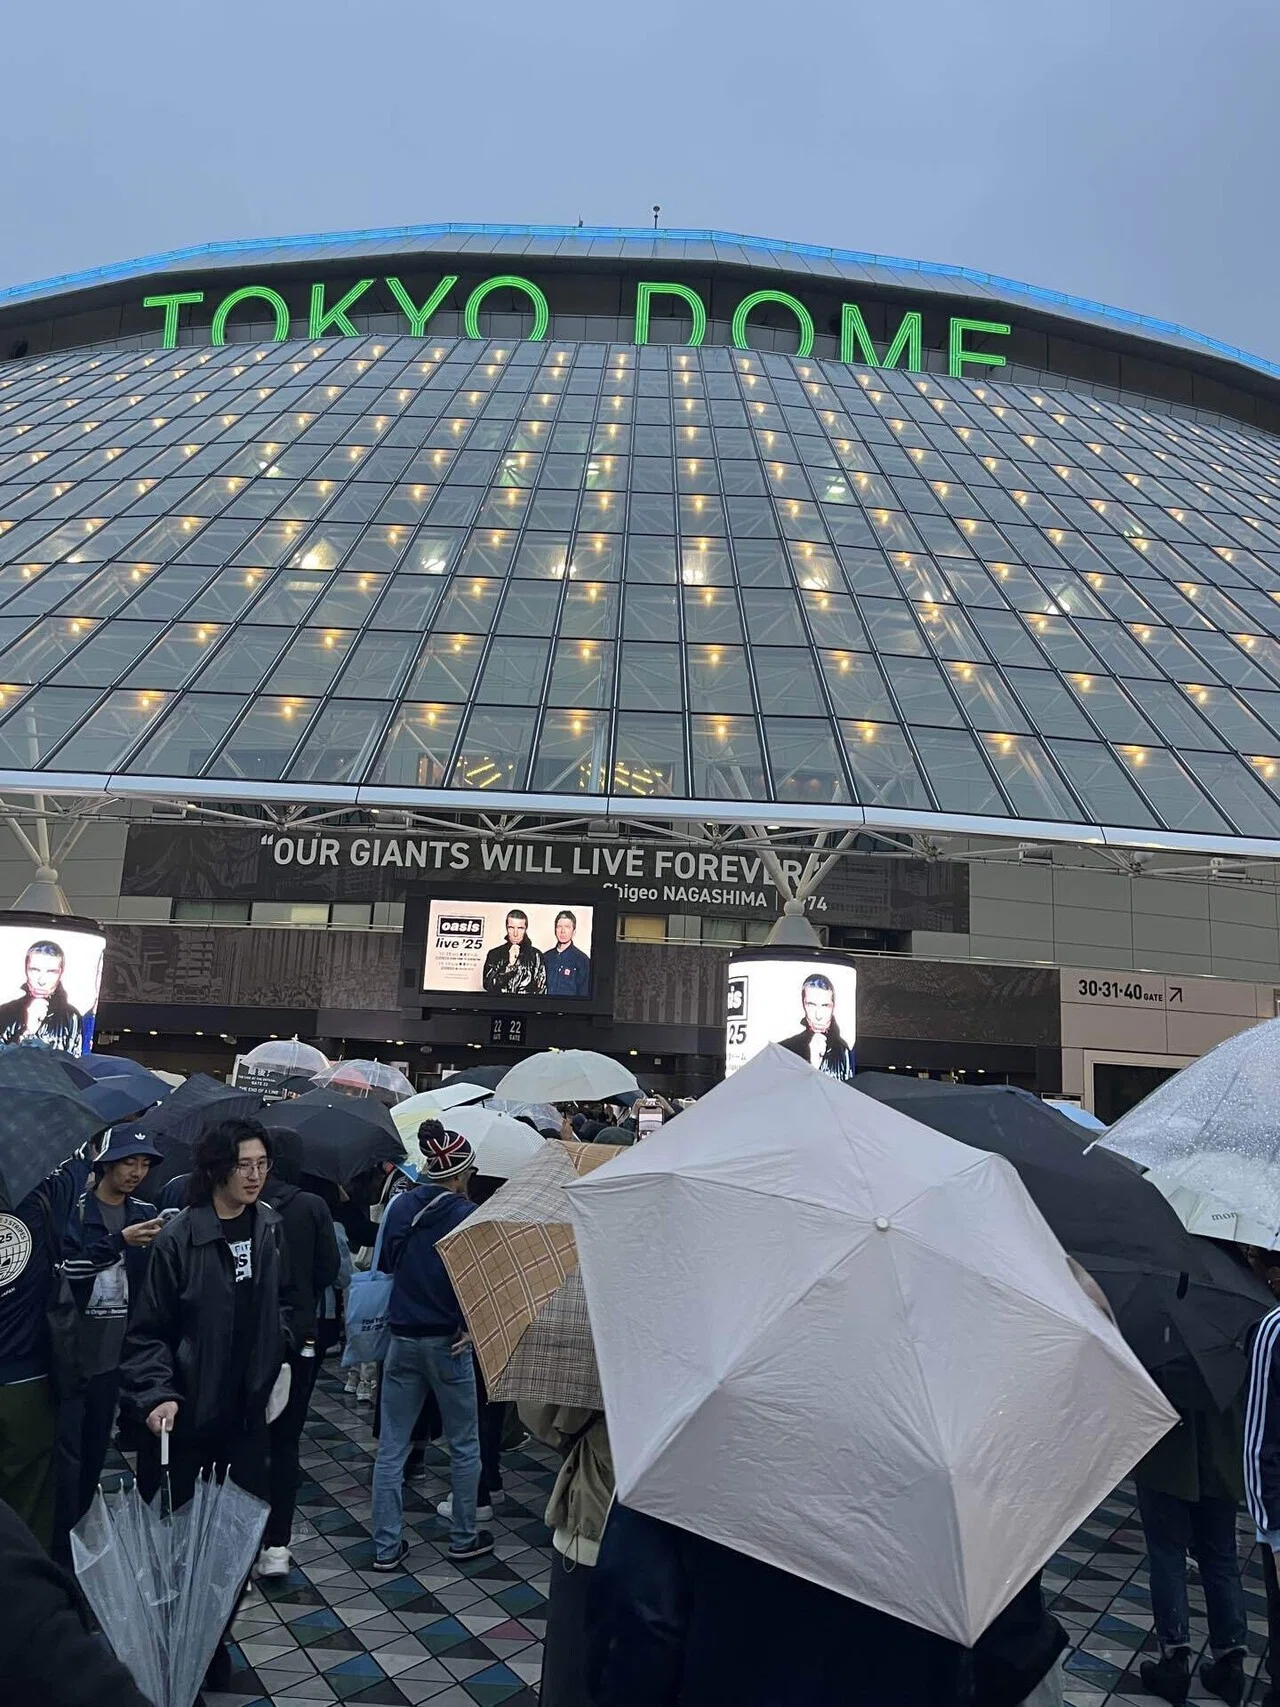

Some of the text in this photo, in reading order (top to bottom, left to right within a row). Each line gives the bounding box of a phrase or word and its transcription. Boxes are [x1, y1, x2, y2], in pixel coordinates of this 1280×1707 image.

[143, 275, 1011, 378] TOKYO DOME
[350, 838, 470, 870] GIANTS
[481, 843, 562, 874] WILL
[573, 847, 645, 877] LIVE
[663, 886, 767, 907] NAGASHIMA
[441, 920, 481, 933] oasis
[435, 938, 460, 949] live
[1143, 993, 1163, 1002] GATE
[494, 1020, 502, 1032] 22
[510, 1020, 521, 1034] 22
[8, 1220, 26, 1240] STRIPES
